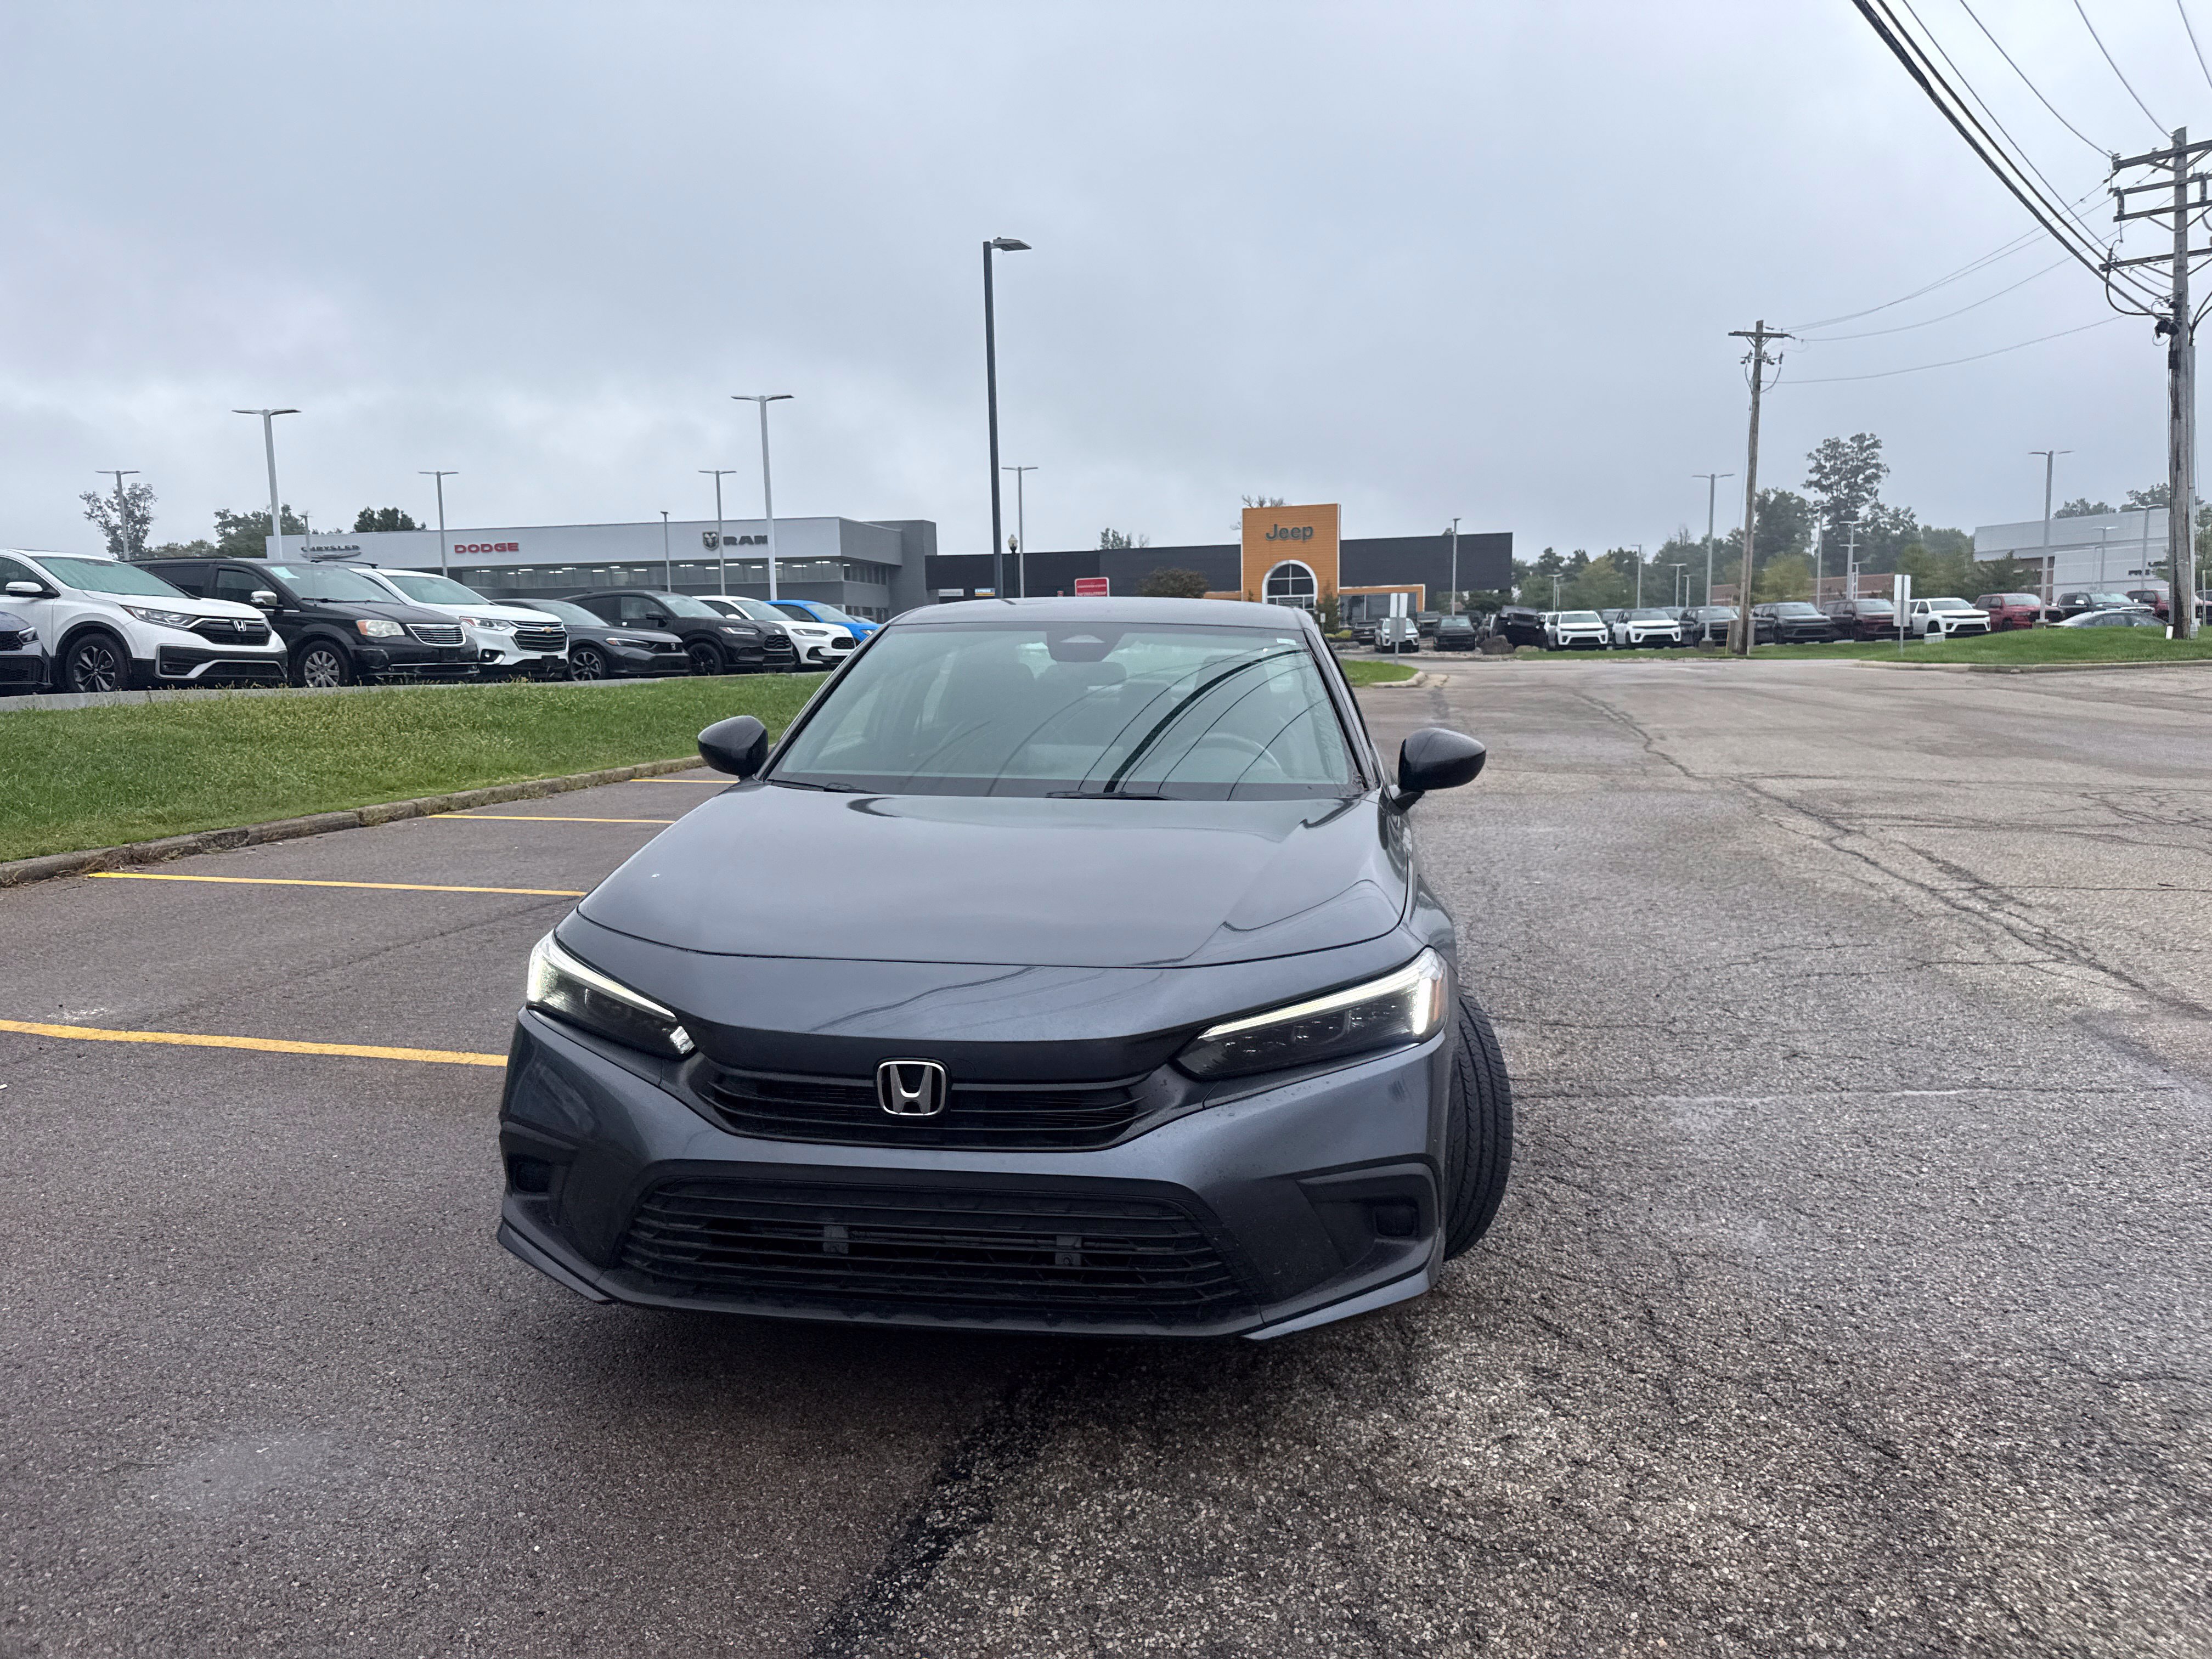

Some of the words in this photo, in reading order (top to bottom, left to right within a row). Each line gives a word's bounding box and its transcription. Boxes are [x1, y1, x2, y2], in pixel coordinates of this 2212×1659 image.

[1265, 523, 1314, 541] Jeep
[723, 535, 768, 546] RAM
[454, 542, 520, 554] DODGE
